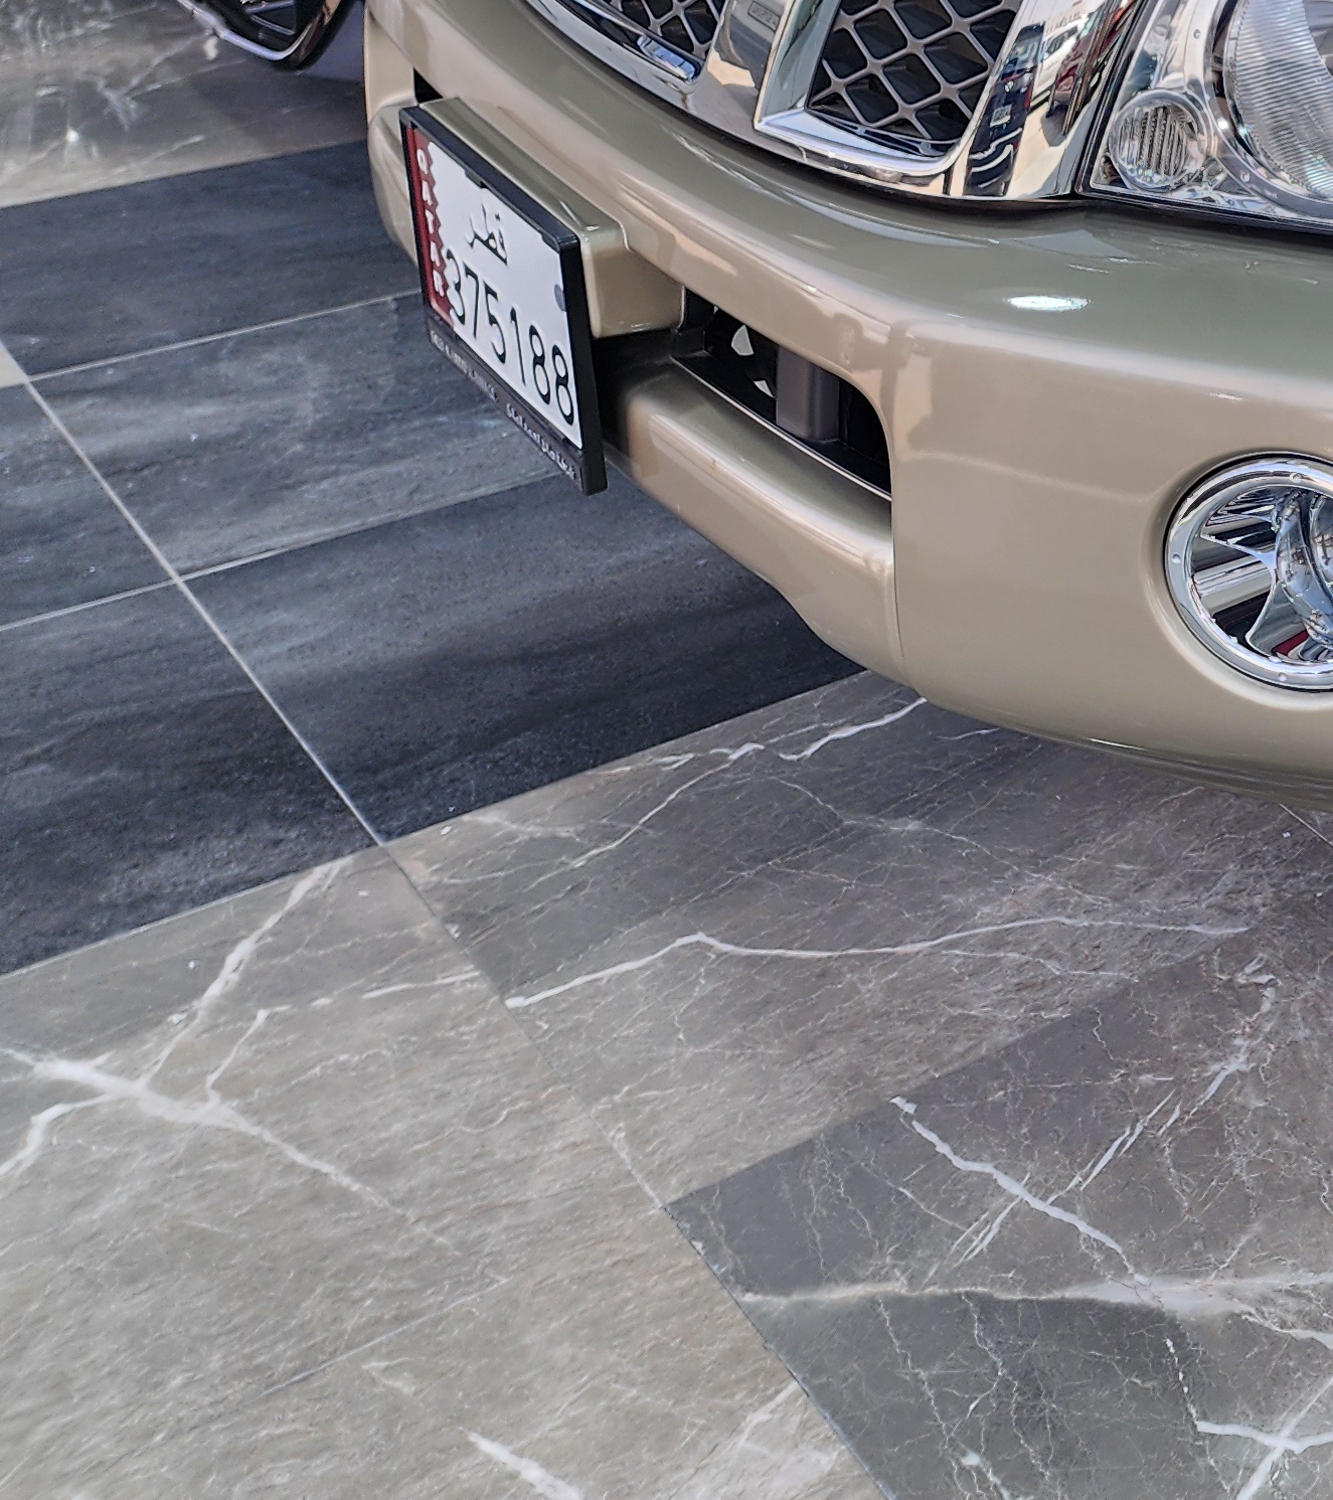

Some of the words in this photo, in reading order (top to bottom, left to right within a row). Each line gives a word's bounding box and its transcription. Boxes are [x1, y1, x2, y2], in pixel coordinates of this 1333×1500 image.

[416, 147, 446, 298] QATAR
[464, 202, 508, 266] قطر
[445, 248, 575, 426] 375188
